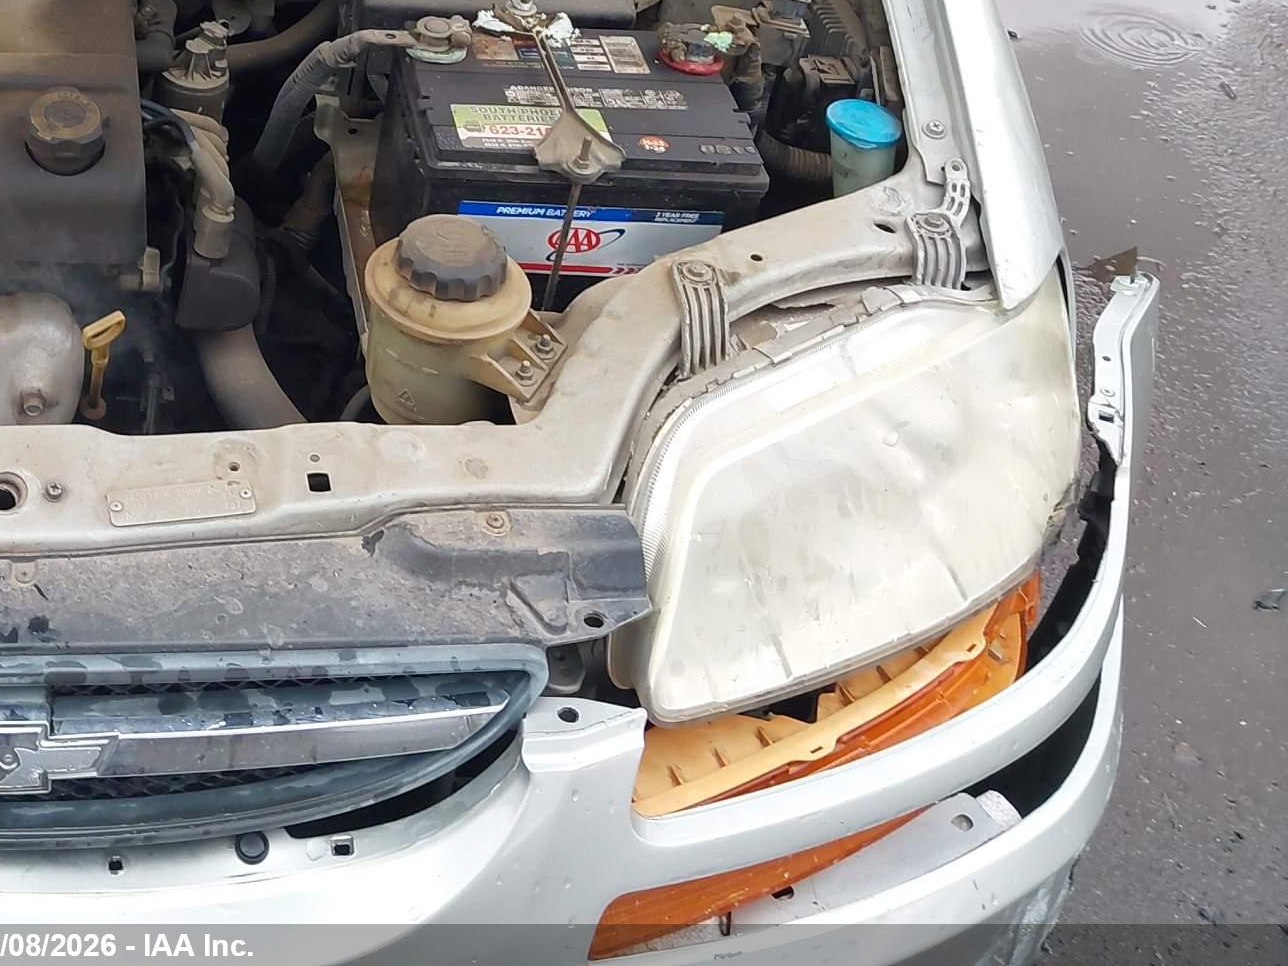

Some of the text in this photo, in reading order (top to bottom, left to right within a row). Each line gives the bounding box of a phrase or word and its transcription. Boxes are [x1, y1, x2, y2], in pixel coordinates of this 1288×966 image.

[471, 105, 562, 117] SOUTH PHOE
[496, 206, 594, 219] PREMIUM BATERY
